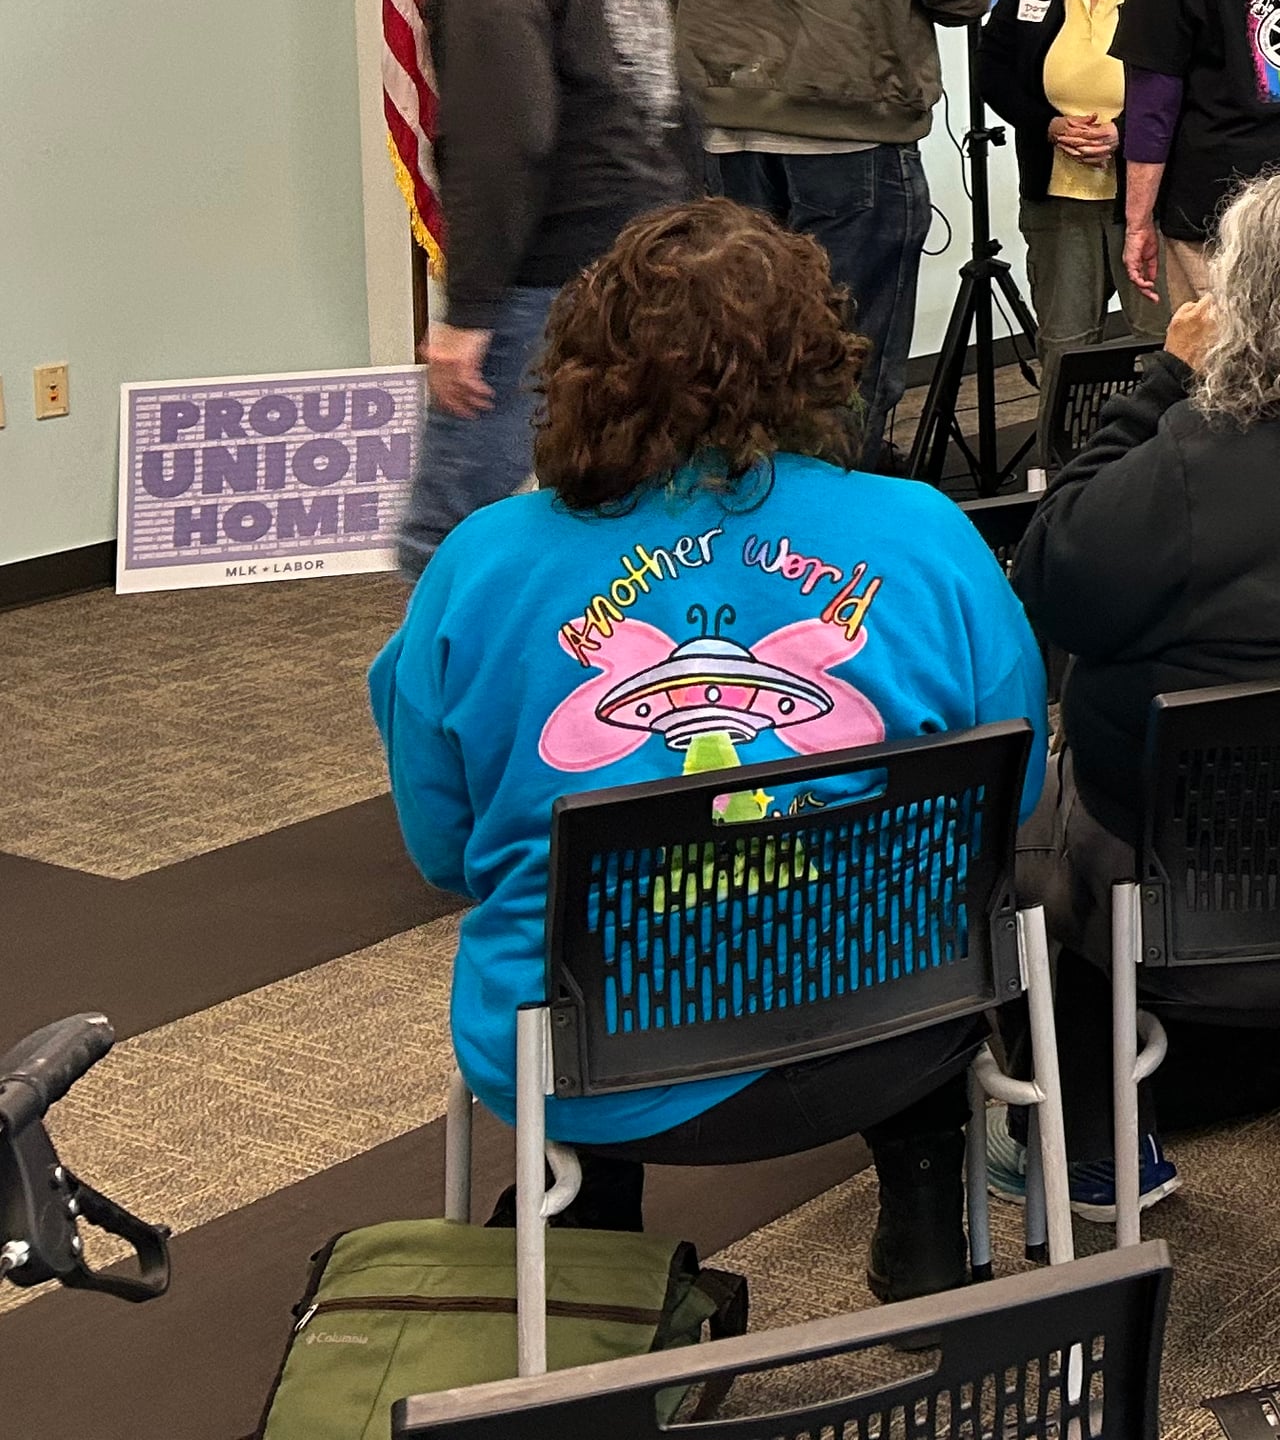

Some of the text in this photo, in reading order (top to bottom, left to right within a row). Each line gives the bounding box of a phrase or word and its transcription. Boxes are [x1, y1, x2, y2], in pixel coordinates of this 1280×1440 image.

[160, 387, 395, 444] PROUD
[142, 433, 411, 498] UNION
[173, 492, 380, 547] HOME
[225, 560, 325, 577] MLK LABOR
[561, 527, 884, 667] Another world
